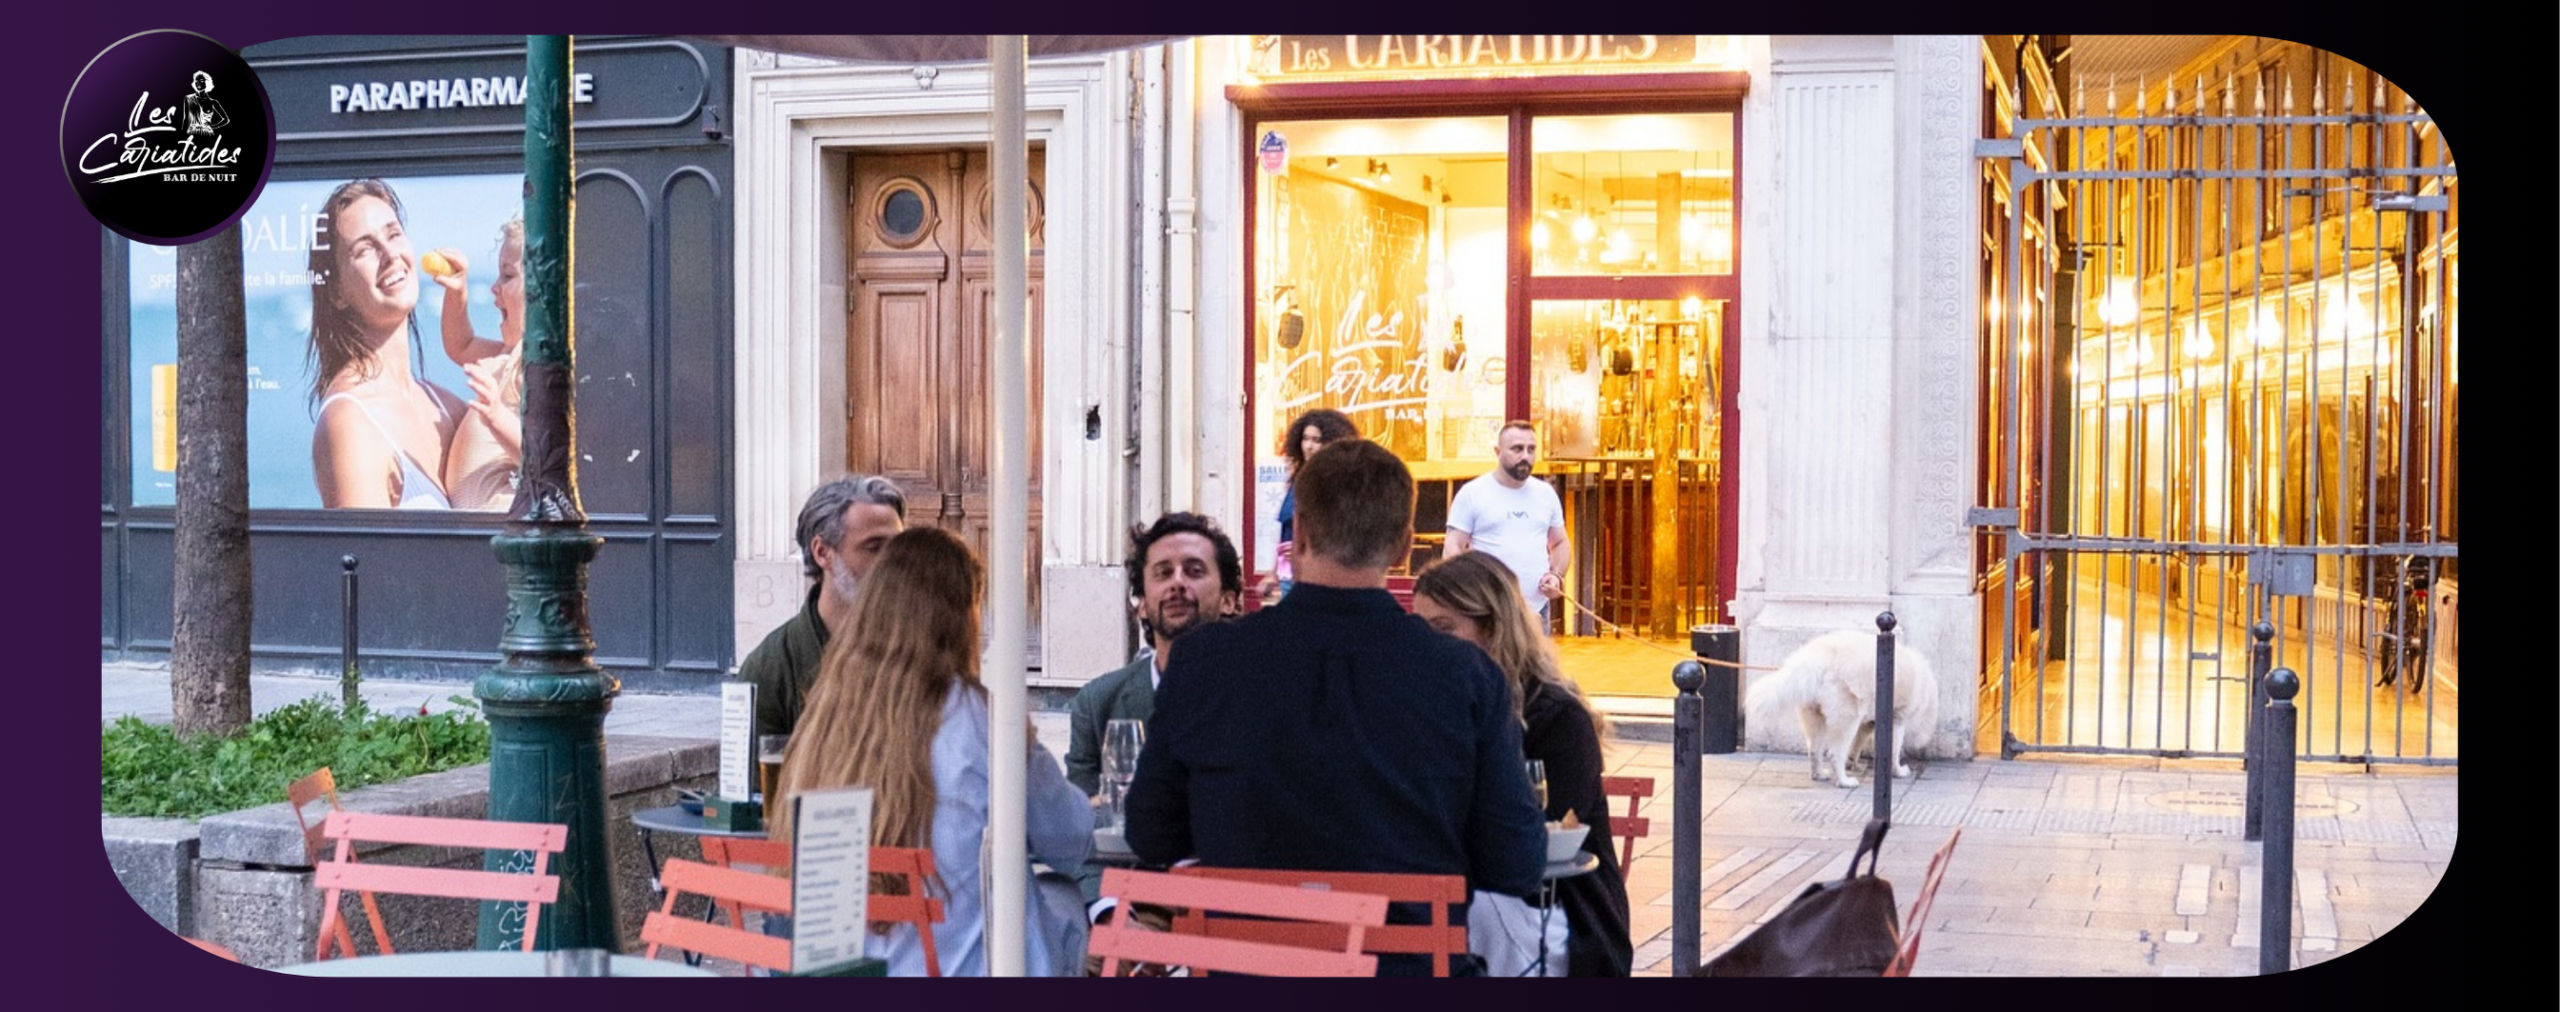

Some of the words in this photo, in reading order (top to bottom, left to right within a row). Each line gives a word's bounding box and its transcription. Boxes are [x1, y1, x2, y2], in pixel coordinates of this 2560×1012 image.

[330, 73, 593, 113] PARAPHARME
[1332, 290, 1403, 357] Les
[1276, 351, 1488, 408] Cariatid
